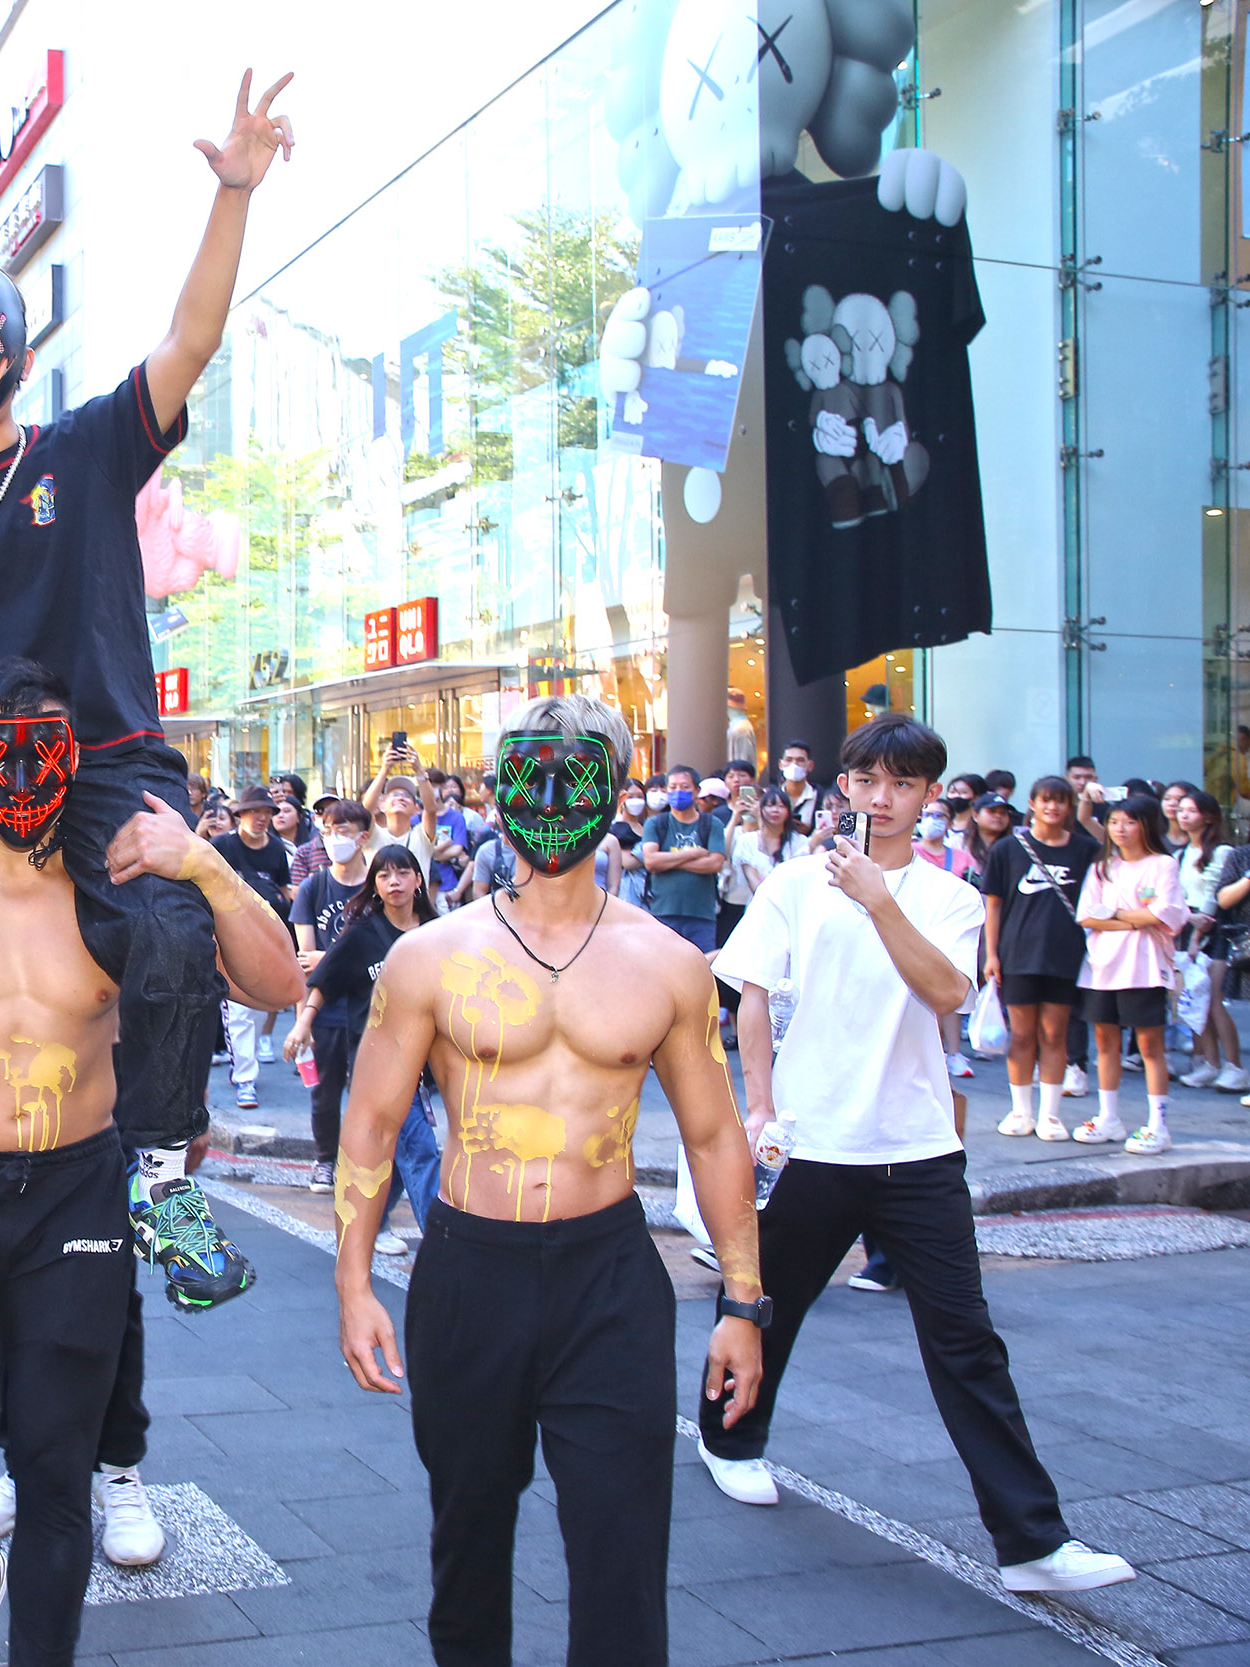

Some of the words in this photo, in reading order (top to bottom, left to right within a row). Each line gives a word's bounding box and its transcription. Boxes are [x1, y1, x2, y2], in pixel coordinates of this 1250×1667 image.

[399, 605, 422, 632] UNI
[399, 631, 424, 660] QLO
[62, 1239, 113, 1254] GYMSHARK
